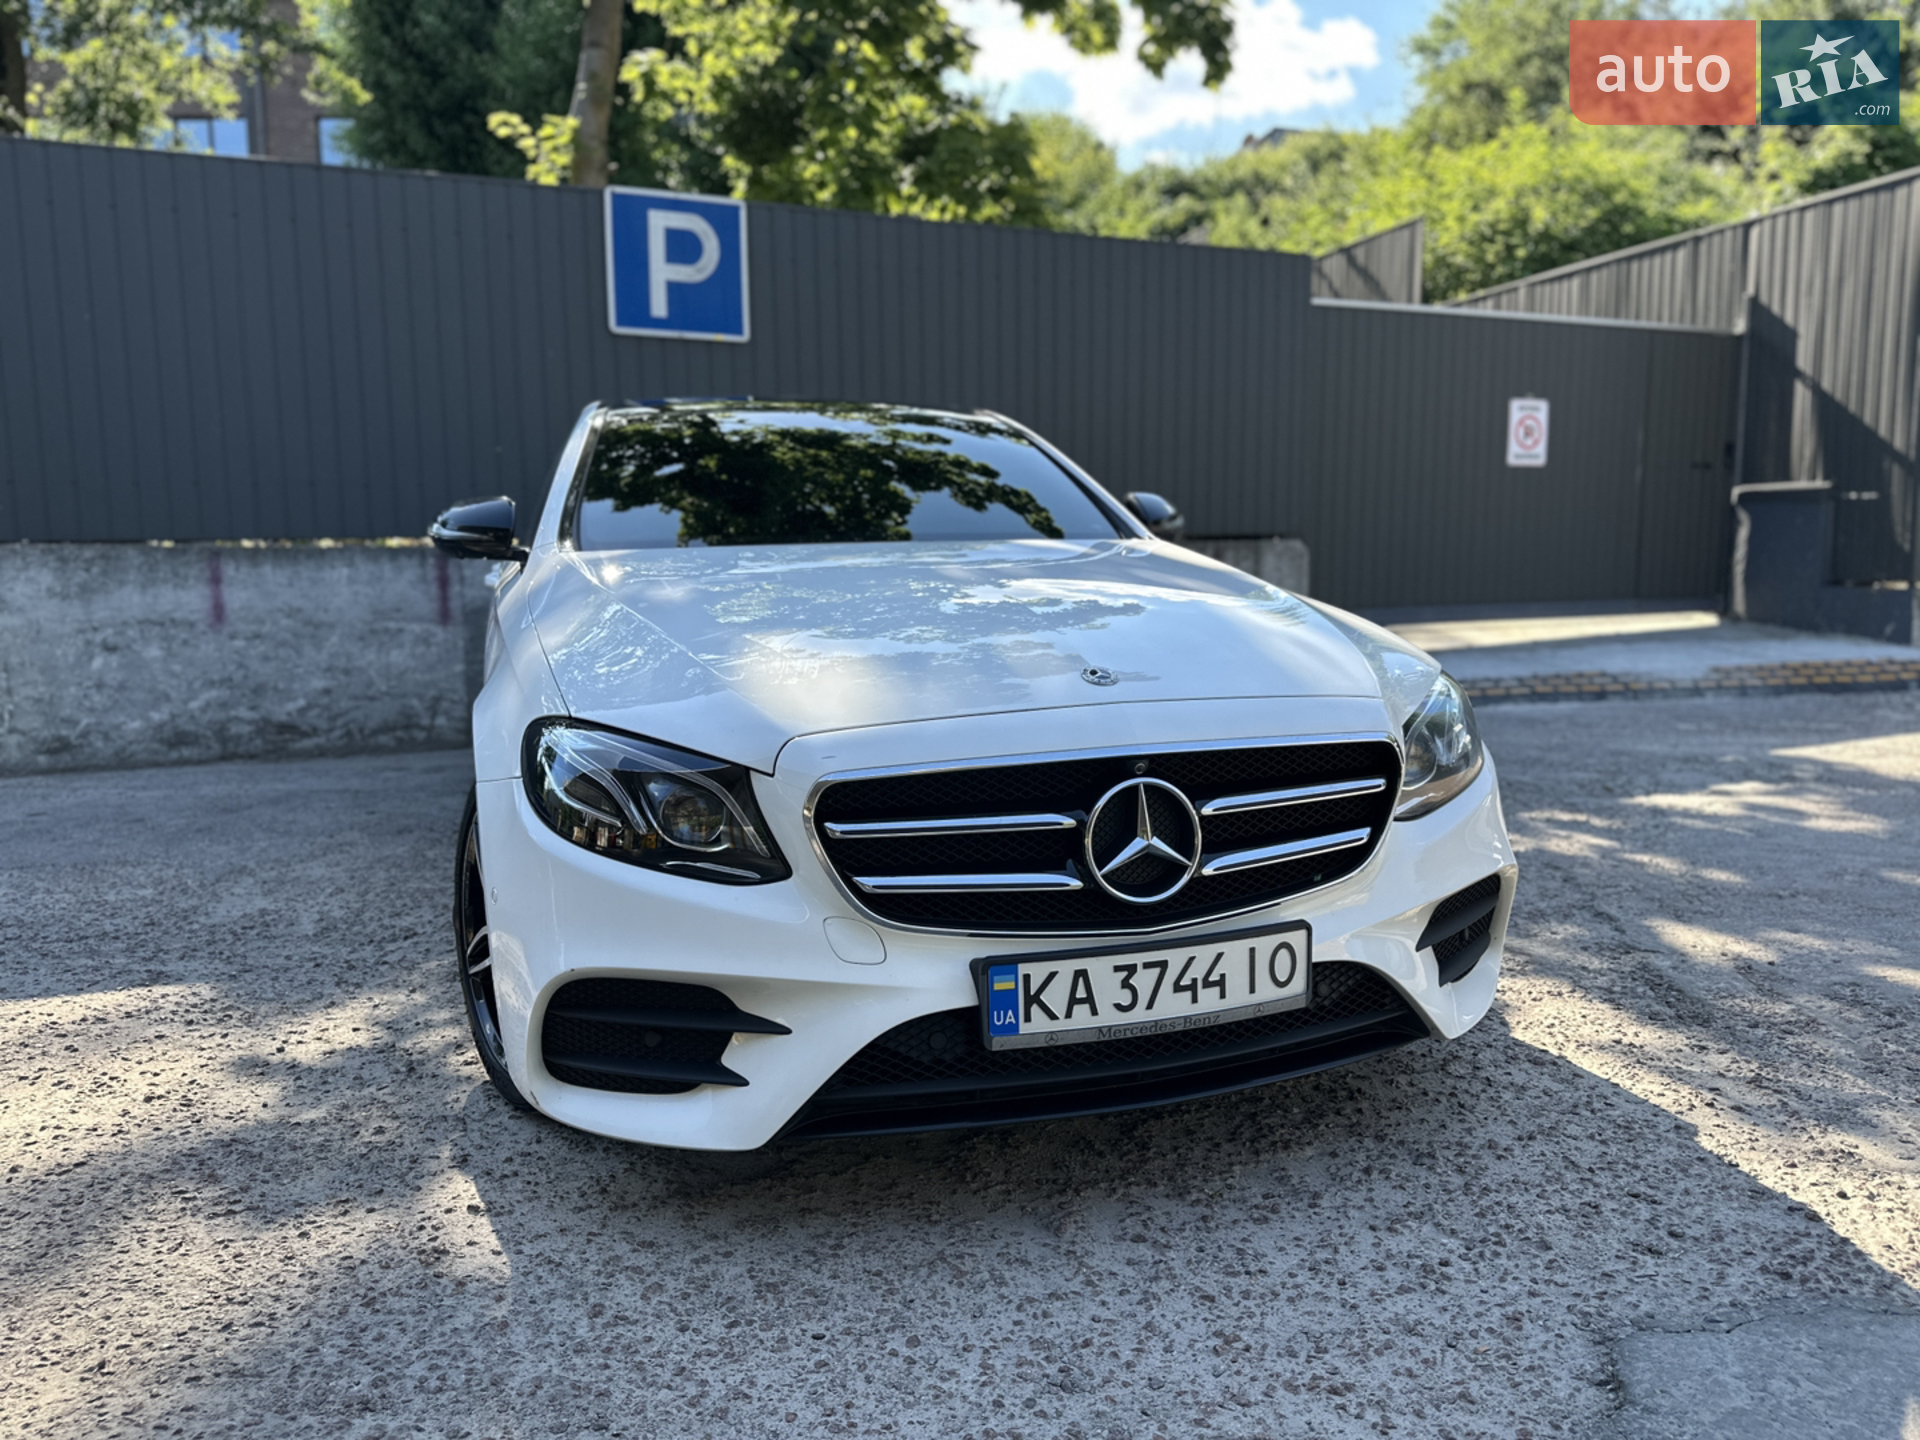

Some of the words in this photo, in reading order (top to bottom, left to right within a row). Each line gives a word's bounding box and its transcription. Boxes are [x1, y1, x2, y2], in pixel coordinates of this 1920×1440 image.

[647, 208, 722, 319] P
[1022, 968, 1099, 1024] KA
[1112, 951, 1227, 1013] 3744
[1248, 941, 1298, 995] IO
[993, 1009, 1017, 1026] UA
[1097, 1014, 1221, 1040] Mercedes-Benz
